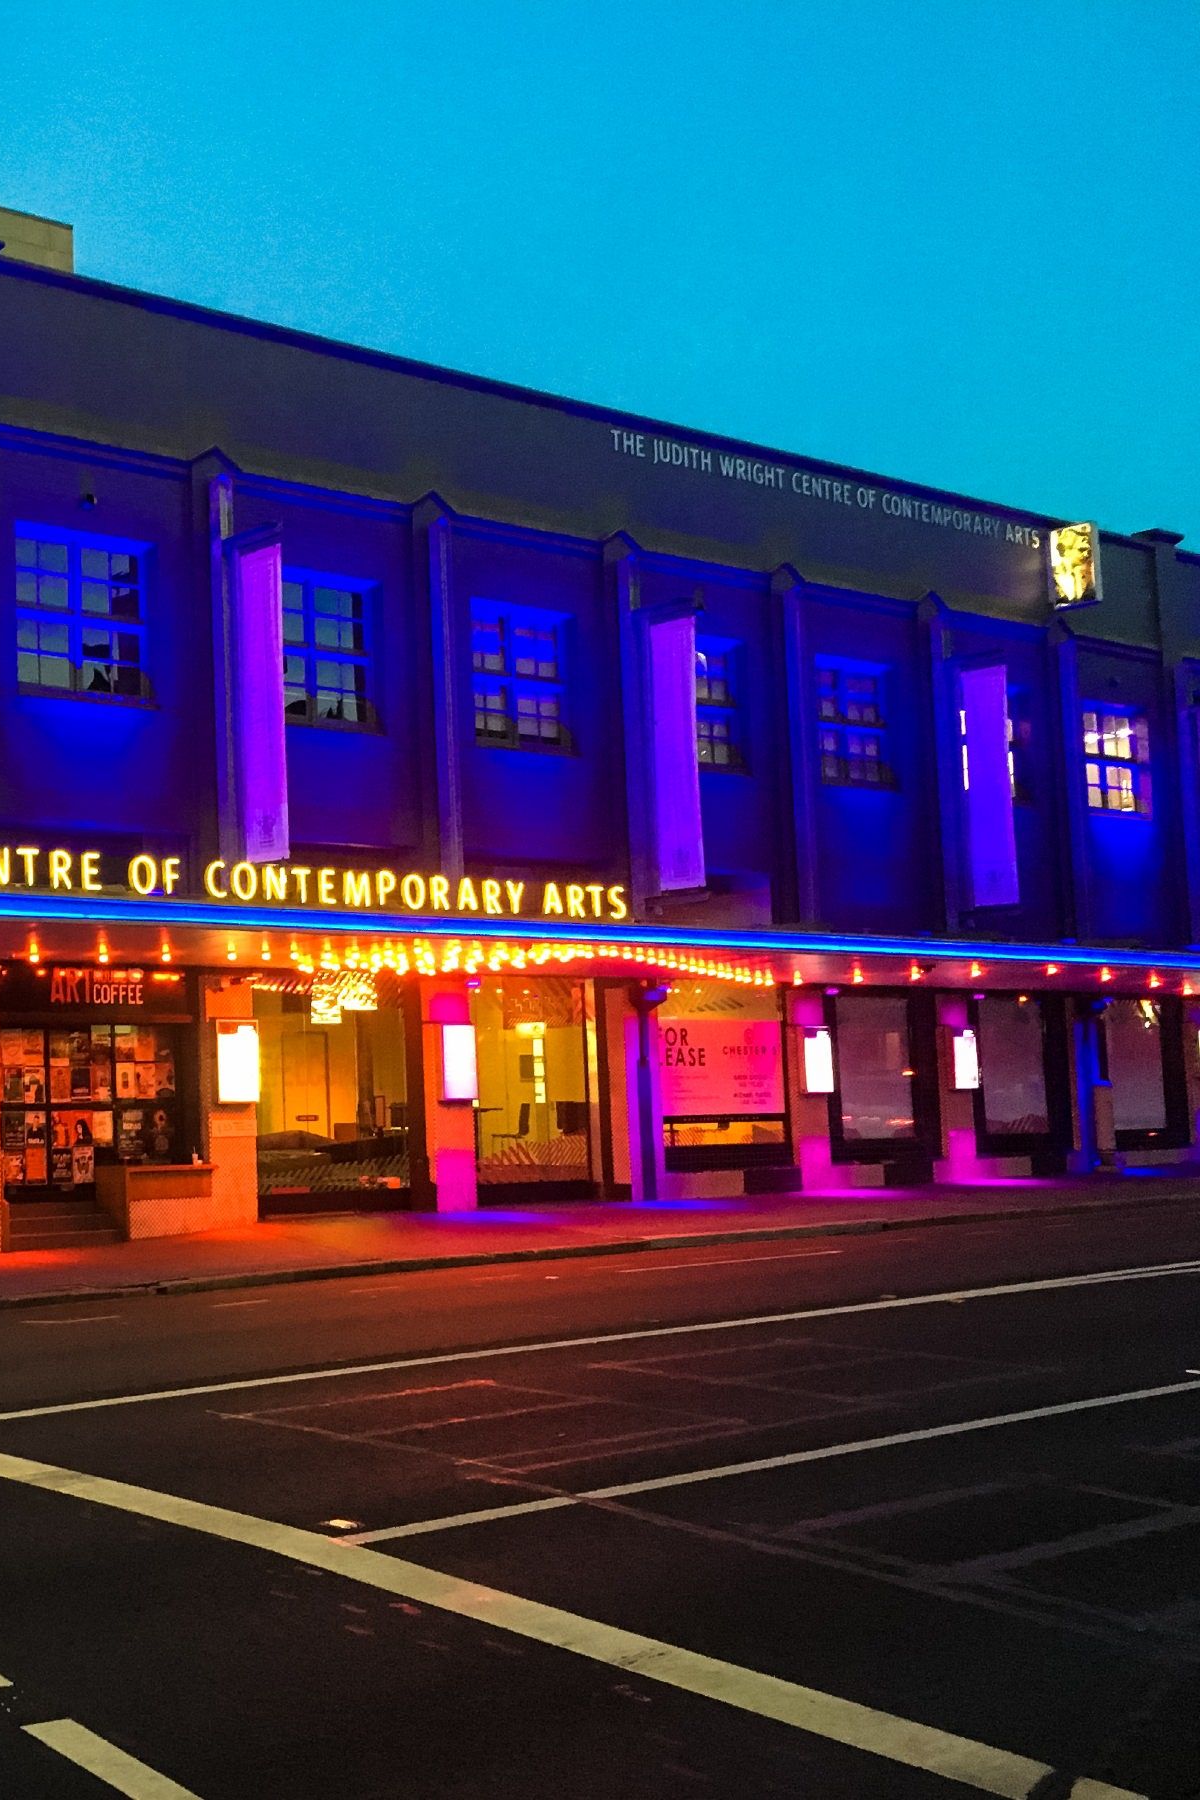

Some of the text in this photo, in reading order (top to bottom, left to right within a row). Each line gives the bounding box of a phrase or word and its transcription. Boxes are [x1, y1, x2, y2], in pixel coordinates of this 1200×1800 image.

[610, 429, 1040, 549] THE JUDITH WRIGHT CENTRE OF CONTEMPORARY ARTS
[128, 854, 181, 895] OF
[203, 859, 525, 915] CONTEMPORARY
[543, 882, 628, 920] ARTS
[50, 967, 93, 1003] ART
[93, 983, 144, 1004] COFFEE
[658, 1047, 706, 1067] EASE
